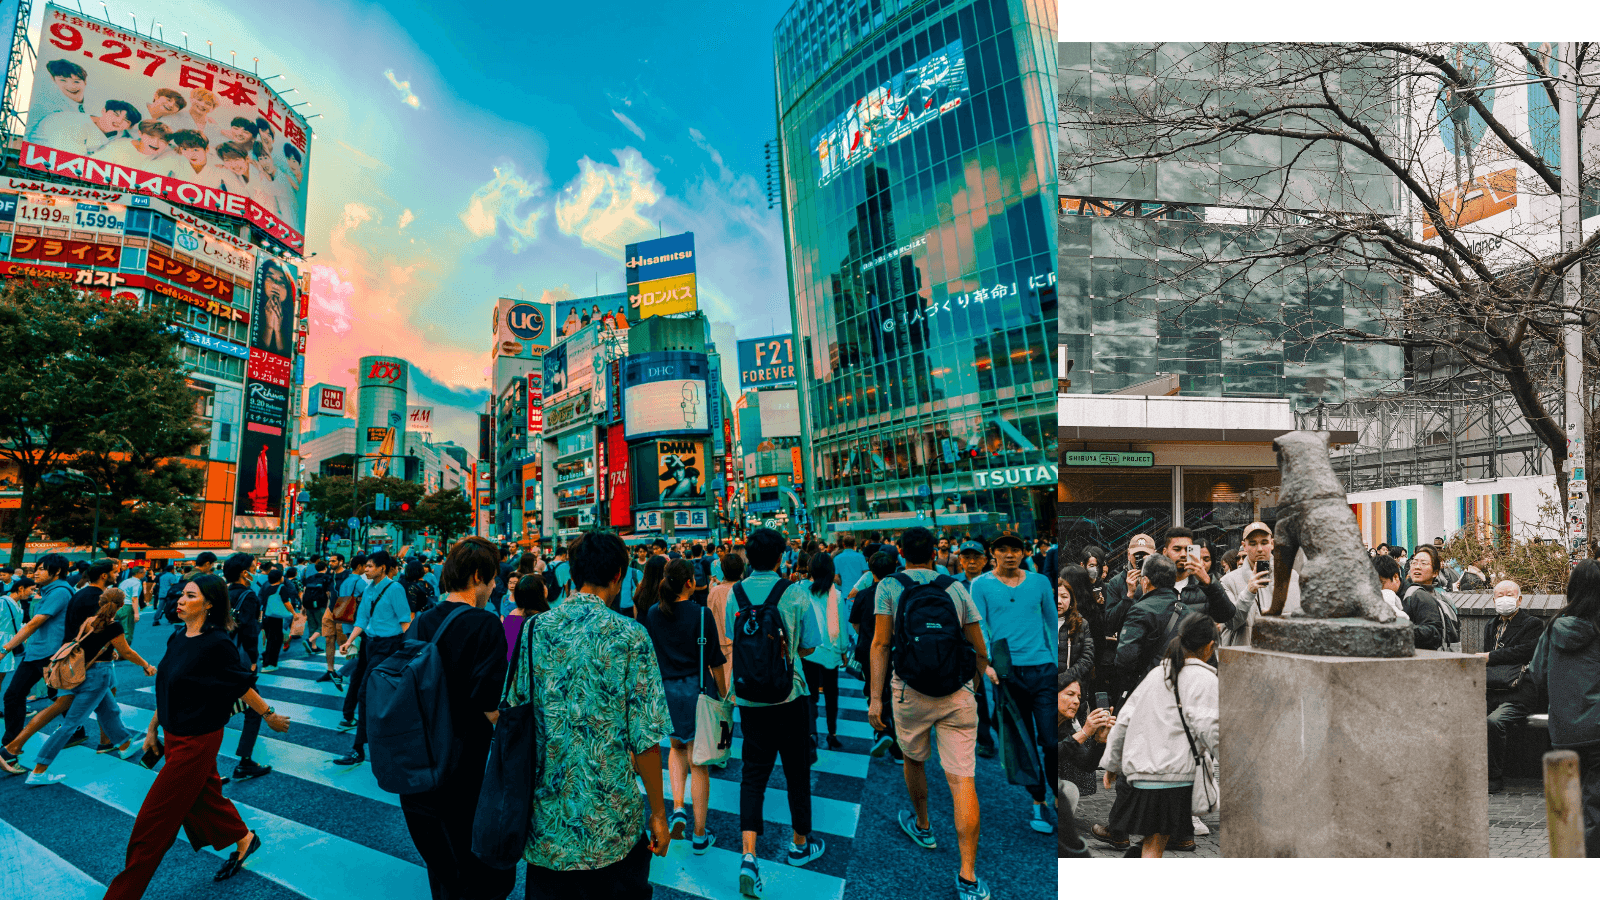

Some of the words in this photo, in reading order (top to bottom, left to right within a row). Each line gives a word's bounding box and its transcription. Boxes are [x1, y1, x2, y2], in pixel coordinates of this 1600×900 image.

[9, 179, 122, 202] しゃぶしゃぶバイキング
[21, 205, 70, 223] 1,199円
[75, 211, 125, 230] 1,599円
[15, 238, 116, 262] プライス
[626, 250, 693, 268] Hisamitsu
[75, 269, 126, 287] ガスト
[147, 253, 230, 295] コンタクト
[206, 300, 243, 321] ガスト
[250, 351, 290, 367] ユリゴコロ
[755, 338, 794, 366] F21
[367, 364, 402, 385] 109
[648, 365, 674, 377] DHC
[742, 365, 796, 383] FOREVER
[324, 390, 340, 399] UNI
[324, 399, 341, 408] QLO
[660, 442, 697, 454] DMM
[660, 454, 685, 467] FX
[639, 512, 704, 527] 大盛書店
